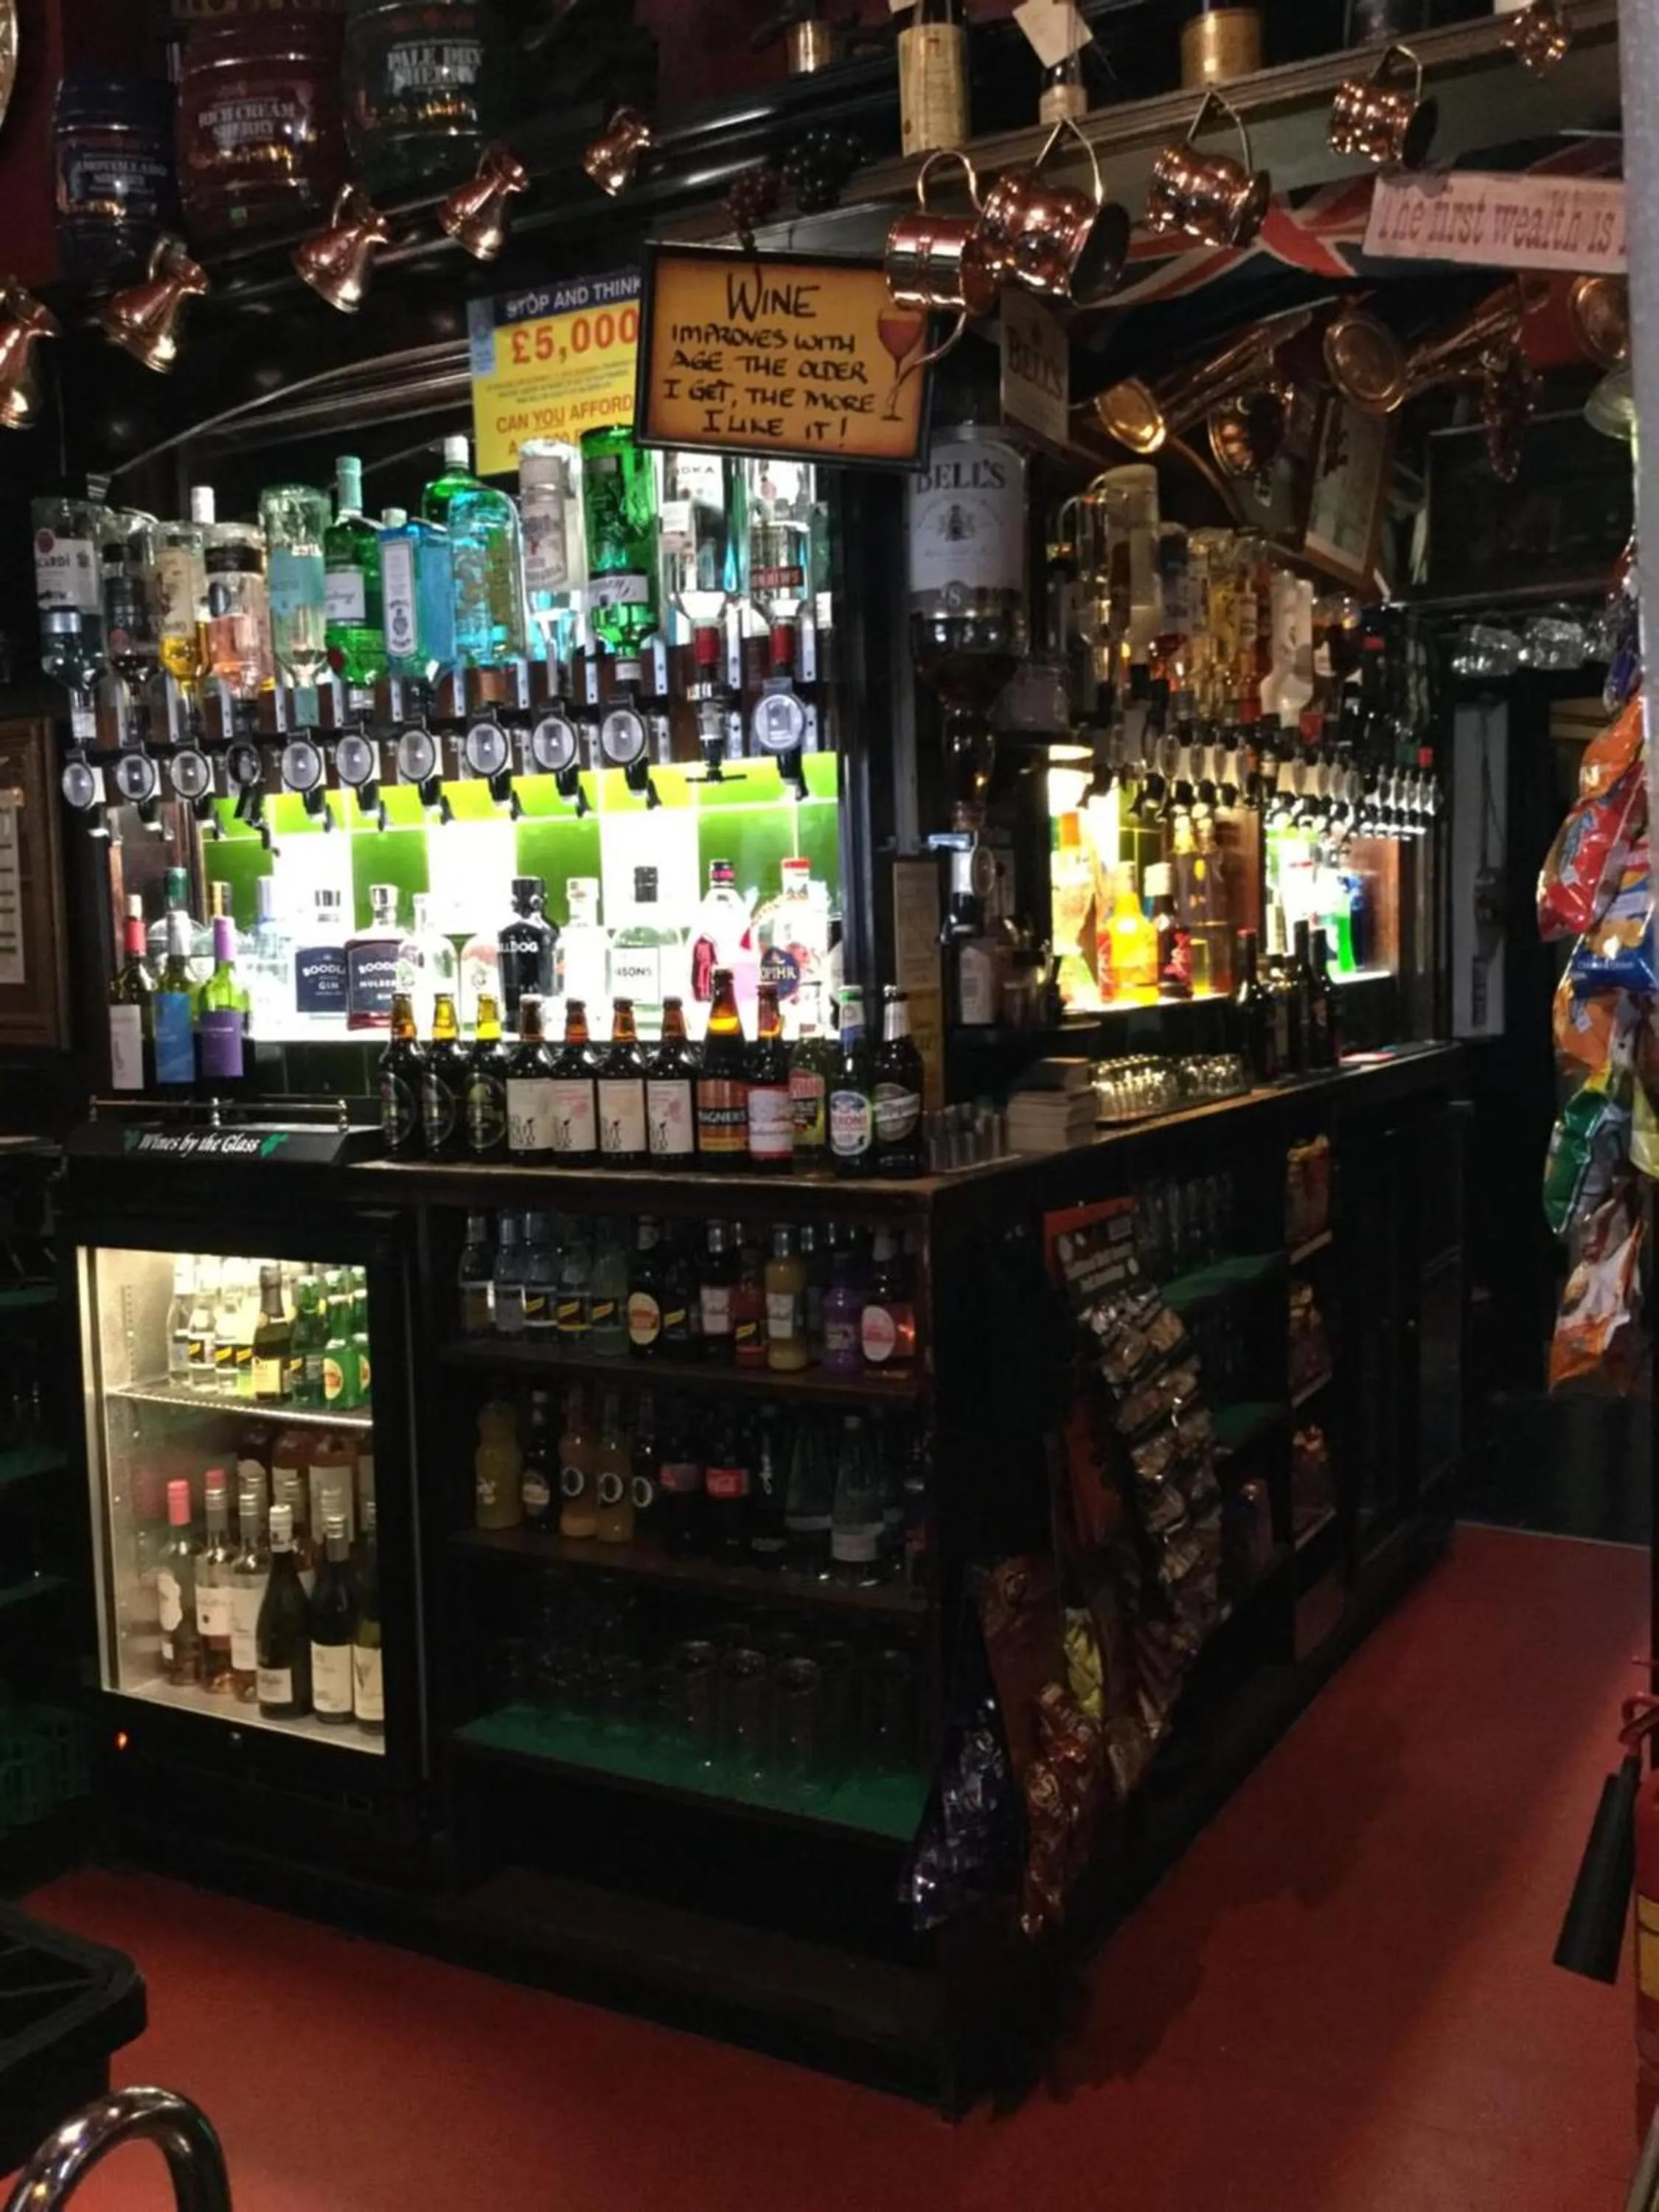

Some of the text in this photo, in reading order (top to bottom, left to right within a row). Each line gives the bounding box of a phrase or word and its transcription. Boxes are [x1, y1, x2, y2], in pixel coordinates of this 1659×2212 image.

[387, 46, 483, 72] PALE DRY
[198, 102, 295, 128] RICH CREAM
[1493, 202, 1579, 253] wealth
[1586, 209, 1616, 256] is
[506, 292, 550, 319] STOP
[553, 285, 589, 310] AND
[726, 262, 821, 323] WINE
[511, 307, 639, 364] £5,000
[671, 323, 856, 355] IMPROVES WITH
[669, 349, 869, 385] AGE THE OLDER
[663, 378, 681, 400] I
[745, 386, 796, 408] THE
[803, 391, 876, 414] MORE
[495, 393, 633, 434] CAN YOU AFFORD
[702, 409, 724, 434] I
[727, 414, 784, 438] LIKE
[318, 981, 339, 991] GIN
[137, 1133, 260, 1158] Wines by the Glass
